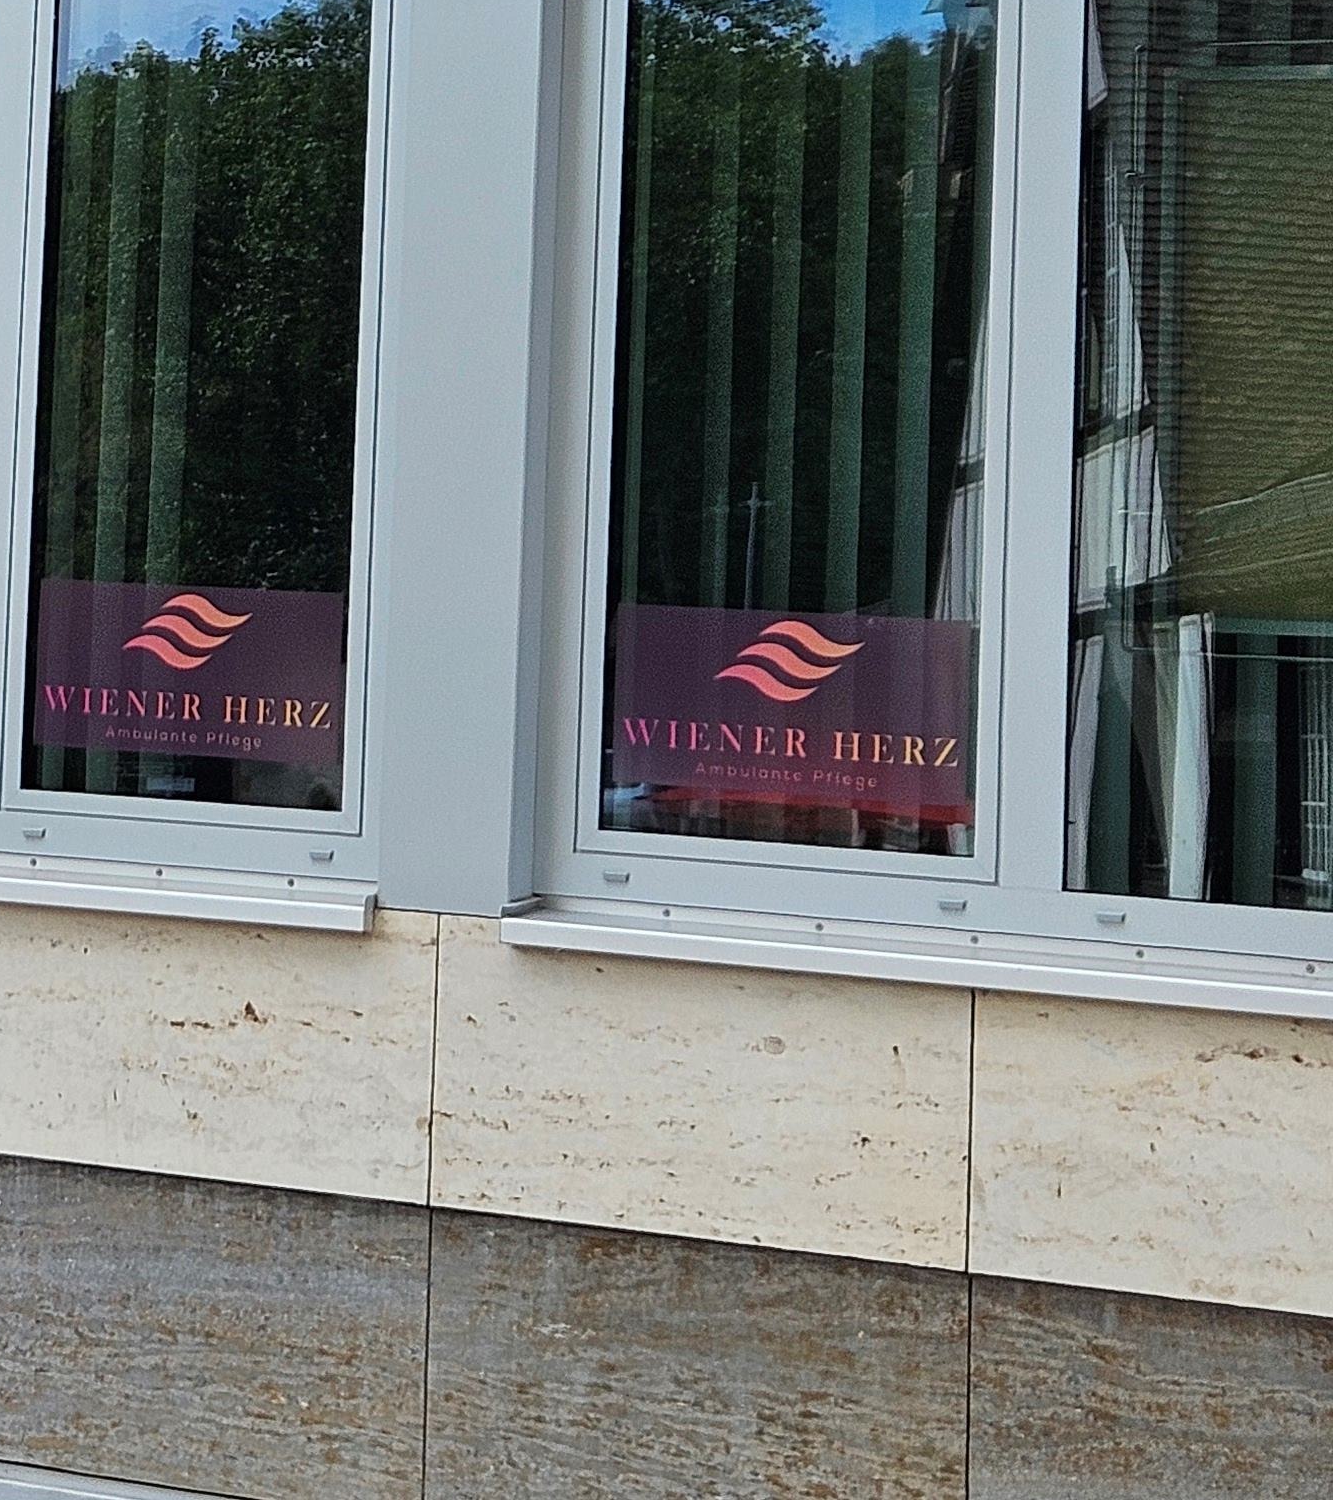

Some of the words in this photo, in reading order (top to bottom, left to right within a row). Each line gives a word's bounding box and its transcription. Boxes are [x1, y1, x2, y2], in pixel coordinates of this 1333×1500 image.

[44, 685, 200, 720] WIENER
[224, 695, 332, 728] HERZ
[104, 725, 199, 744] Ambulante
[206, 731, 263, 752] Pflege
[622, 718, 806, 757] WIENER
[833, 731, 958, 766] HERZ
[694, 761, 804, 784] Ambulante
[812, 769, 879, 791] Pflege
